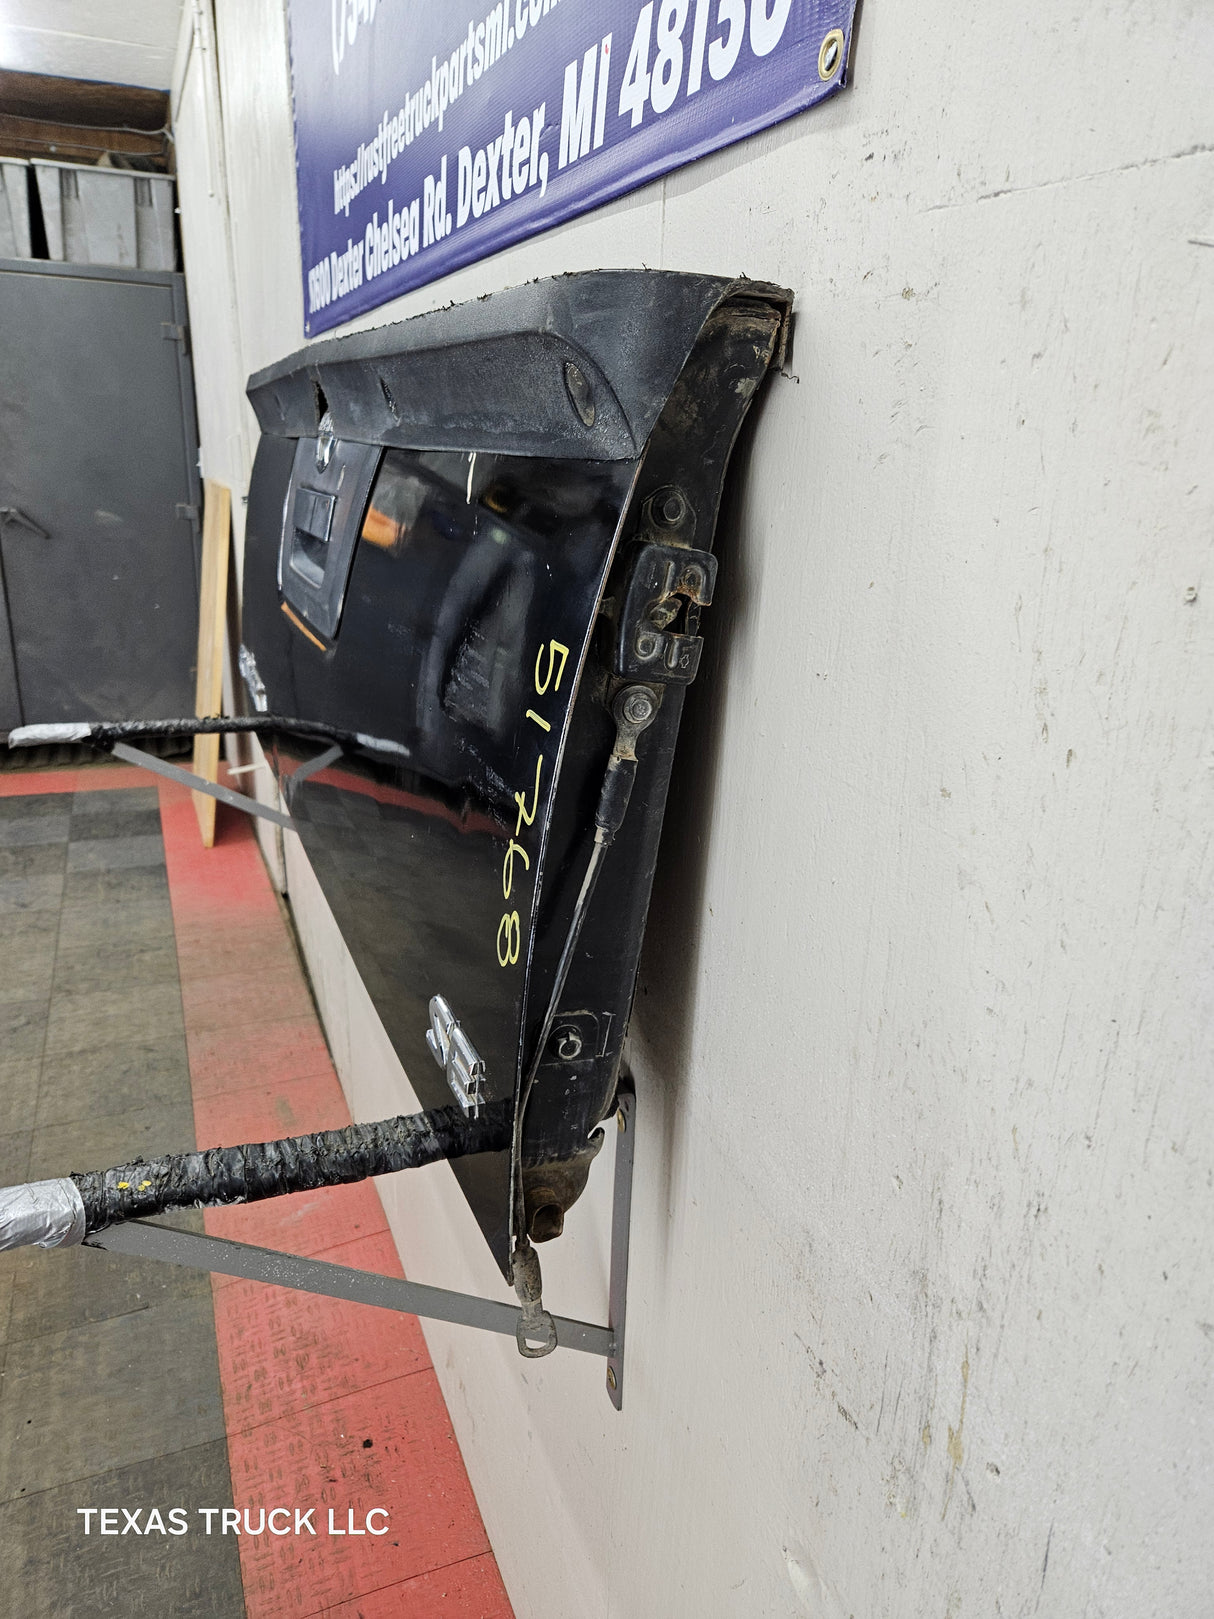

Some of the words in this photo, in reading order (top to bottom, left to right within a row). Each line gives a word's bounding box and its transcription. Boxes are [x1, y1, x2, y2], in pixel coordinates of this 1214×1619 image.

[330, 239, 364, 301] Dexter
[365, 196, 420, 281] Chelsea
[422, 154, 452, 248] Rd.
[456, 102, 549, 228] Dexter,
[558, 32, 612, 170] MI
